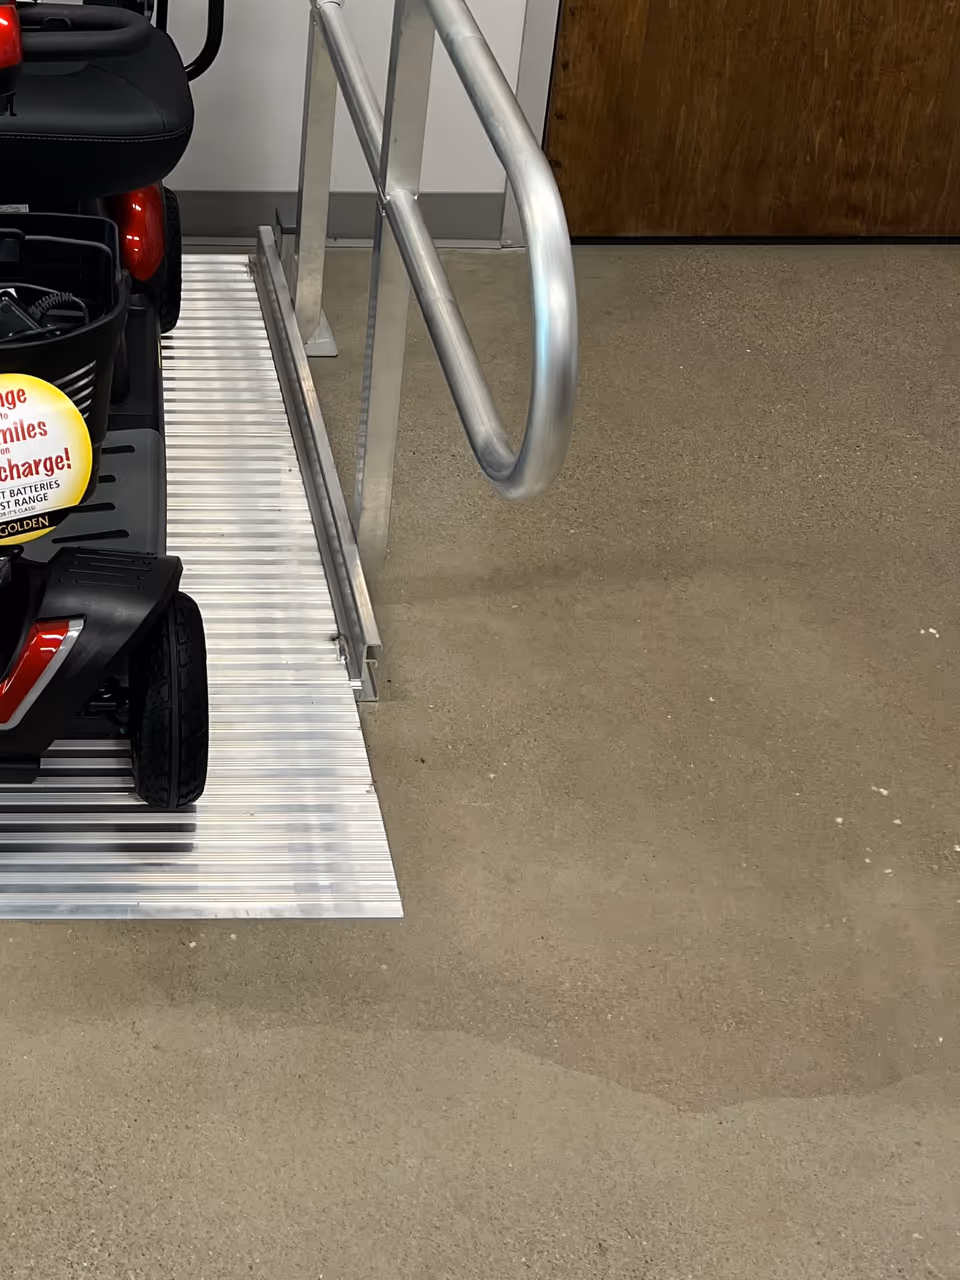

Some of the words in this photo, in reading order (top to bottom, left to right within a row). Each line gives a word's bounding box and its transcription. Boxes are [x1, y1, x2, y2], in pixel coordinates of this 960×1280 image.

[0, 412, 9, 421] to
[0, 447, 11, 456] on
[9, 479, 61, 498] BATTERIES
[14, 492, 49, 508] RANGE
[6, 508, 18, 516] IT'S
[17, 505, 37, 514] CLASS!
